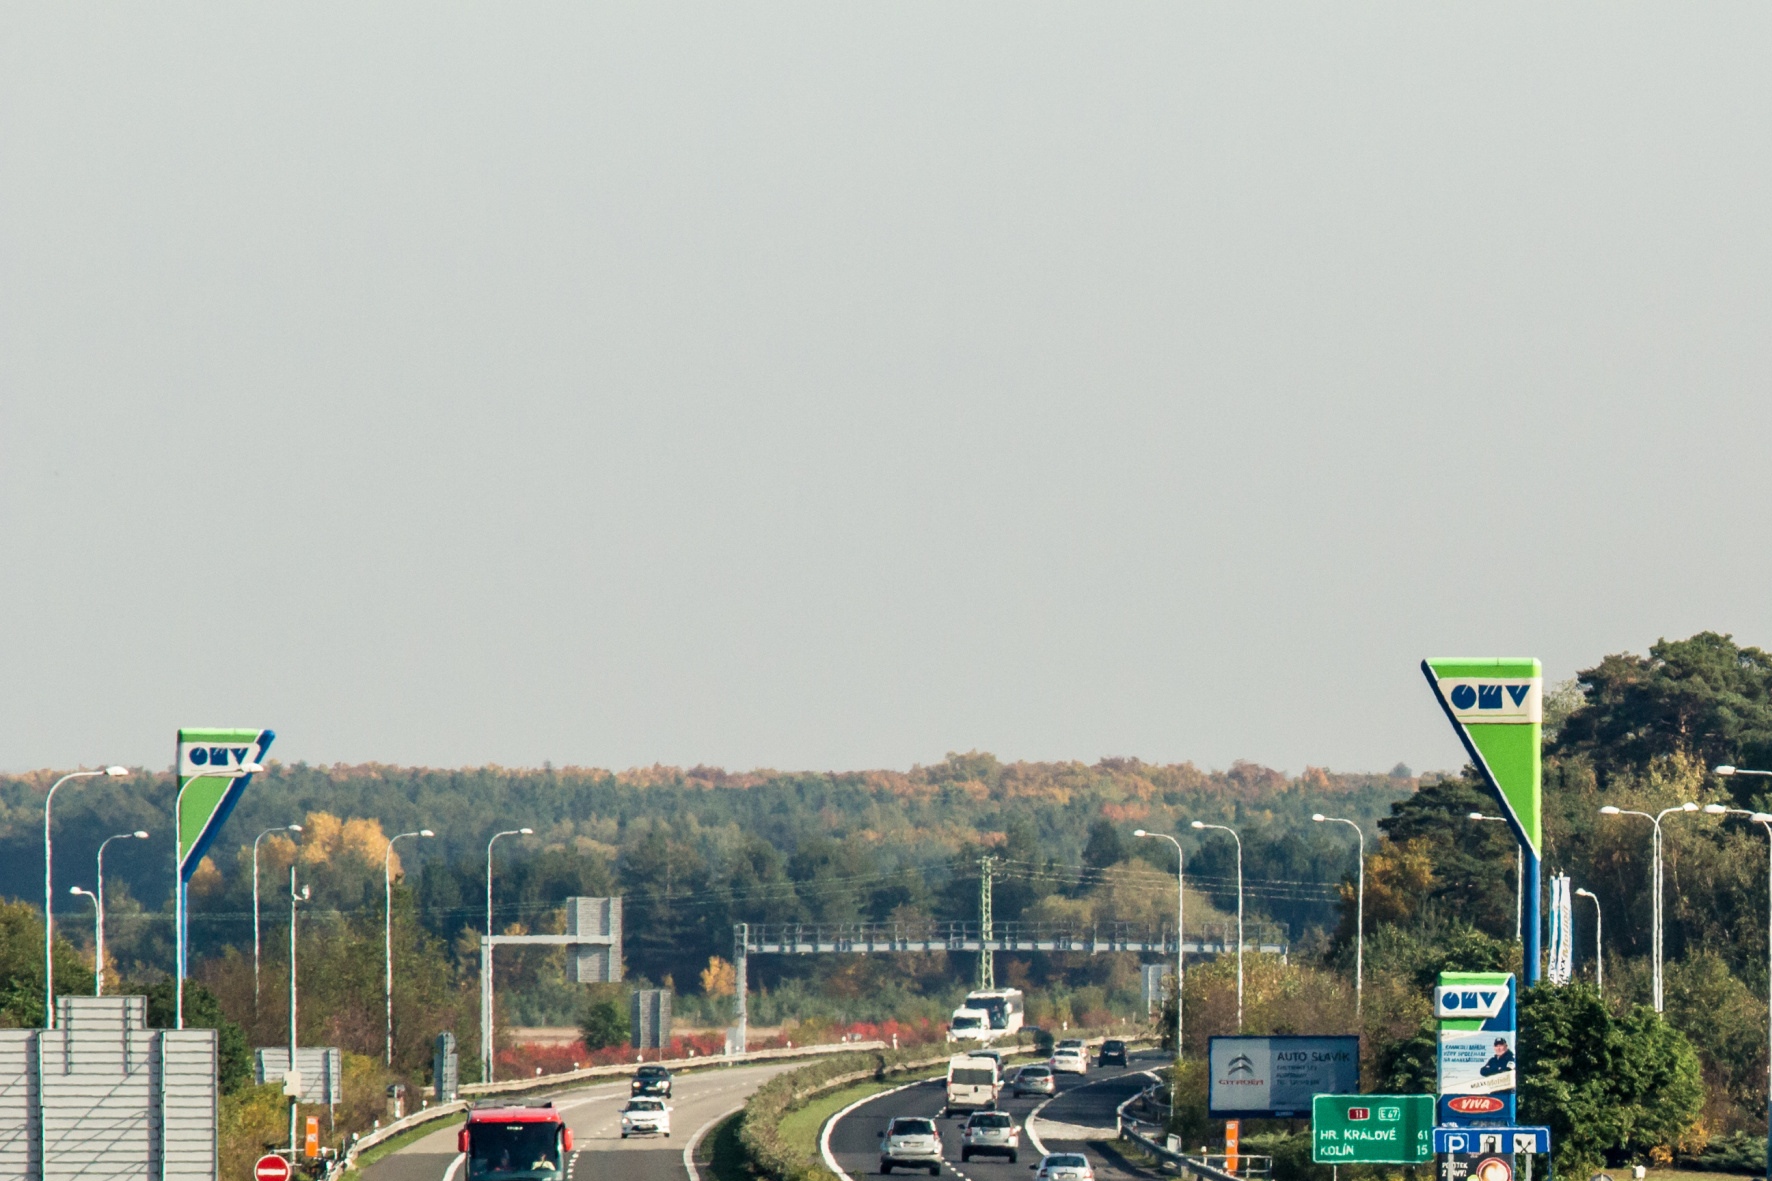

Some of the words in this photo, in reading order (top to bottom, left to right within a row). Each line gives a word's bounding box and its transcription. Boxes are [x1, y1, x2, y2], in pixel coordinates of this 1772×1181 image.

[1451, 684, 1531, 710] OMV
[189, 747, 249, 766] OMV
[1442, 992, 1497, 1010] OMV
[1277, 1052, 1307, 1062] AUTO
[1461, 1099, 1491, 1110] VIVA
[1355, 1110, 1363, 1118] 11
[1380, 1110, 1386, 1118] E
[1388, 1110, 1399, 1118] 67
[1320, 1130, 1339, 1140] HR.
[1344, 1127, 1397, 1140] KRÁLOVÉ
[1417, 1130, 1428, 1140] 61
[1320, 1143, 1354, 1156] KOLÍN
[1417, 1145, 1428, 1155] 15
[1449, 1135, 1464, 1153] P
